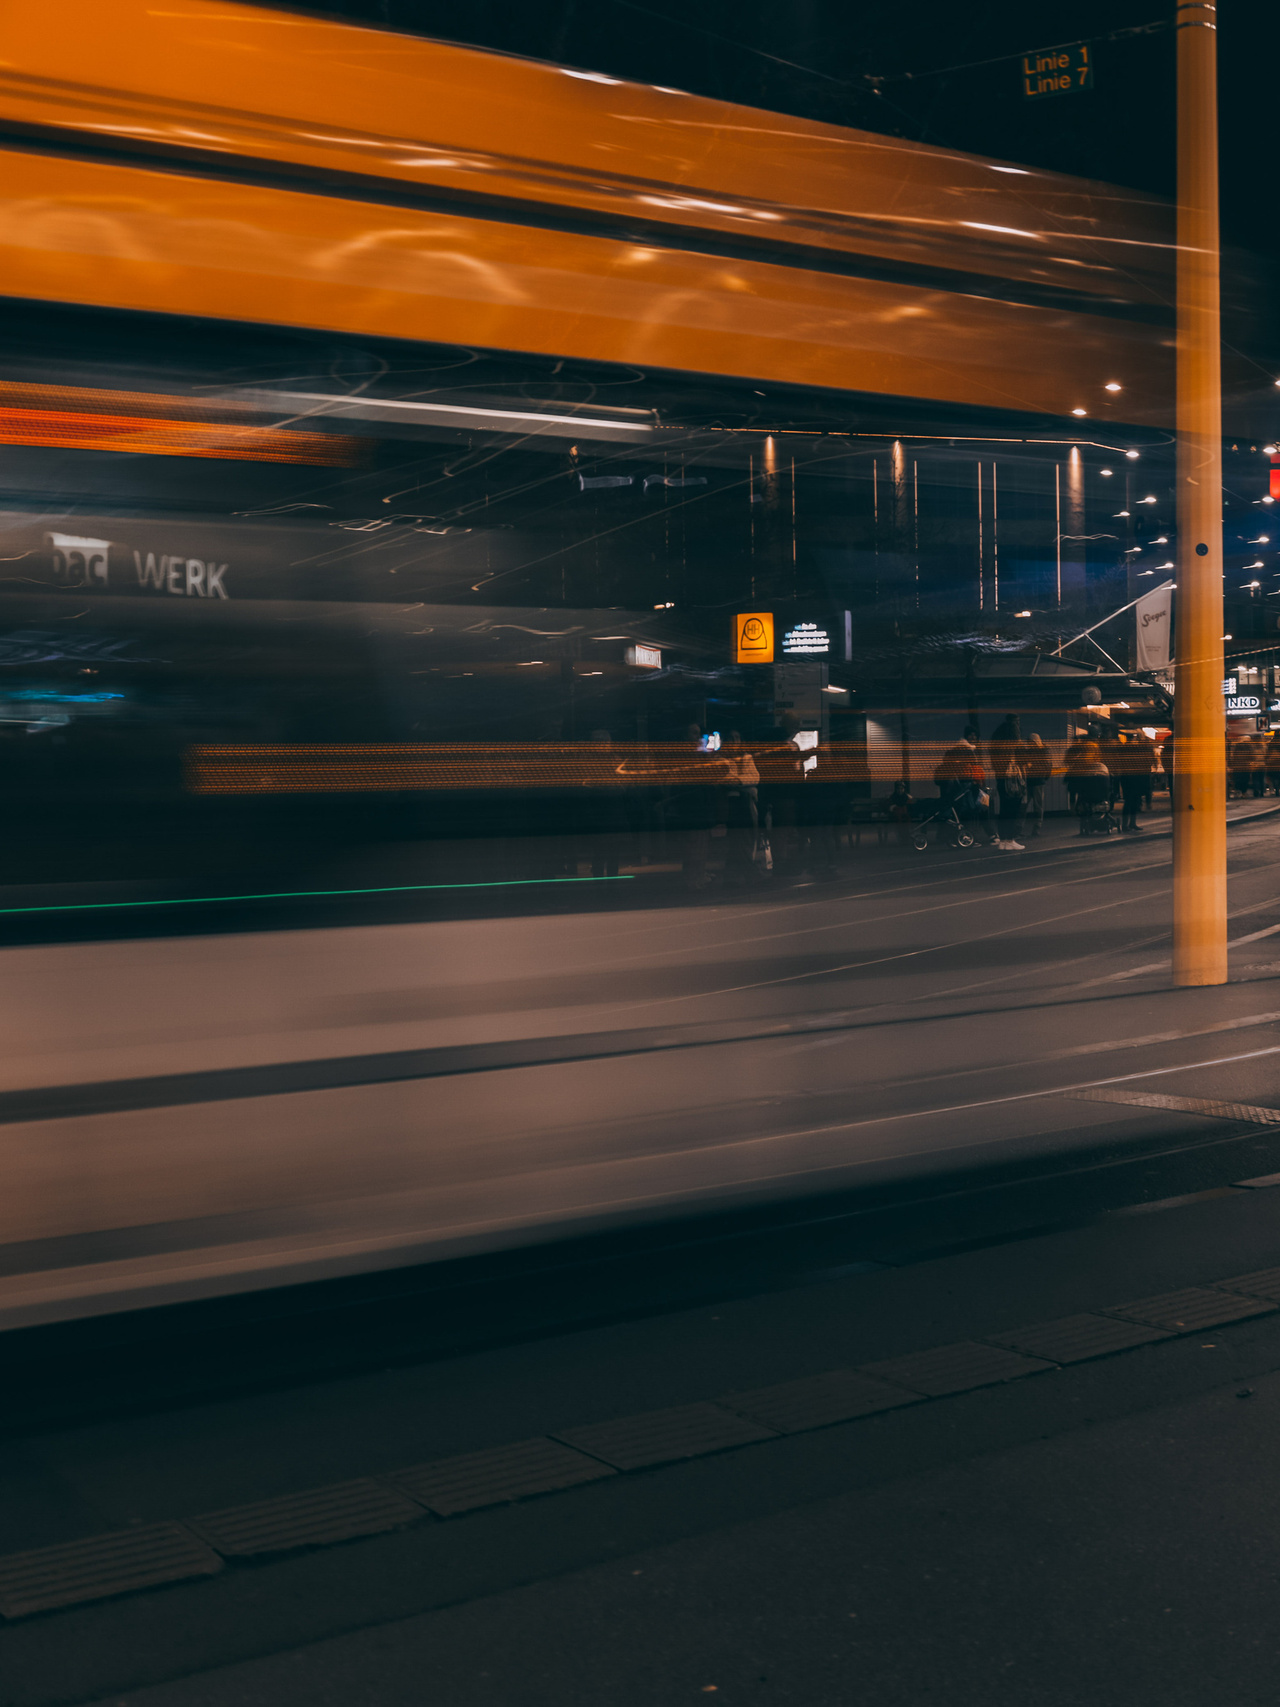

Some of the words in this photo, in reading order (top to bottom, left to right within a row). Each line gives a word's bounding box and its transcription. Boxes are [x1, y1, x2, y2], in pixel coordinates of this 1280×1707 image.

[1024, 52, 1070, 75] Linie
[1079, 46, 1088, 63] 1
[1025, 73, 1071, 95] Linie
[1077, 67, 1089, 85] 7
[133, 549, 229, 600] WERK
[1228, 697, 1260, 709] NKD
